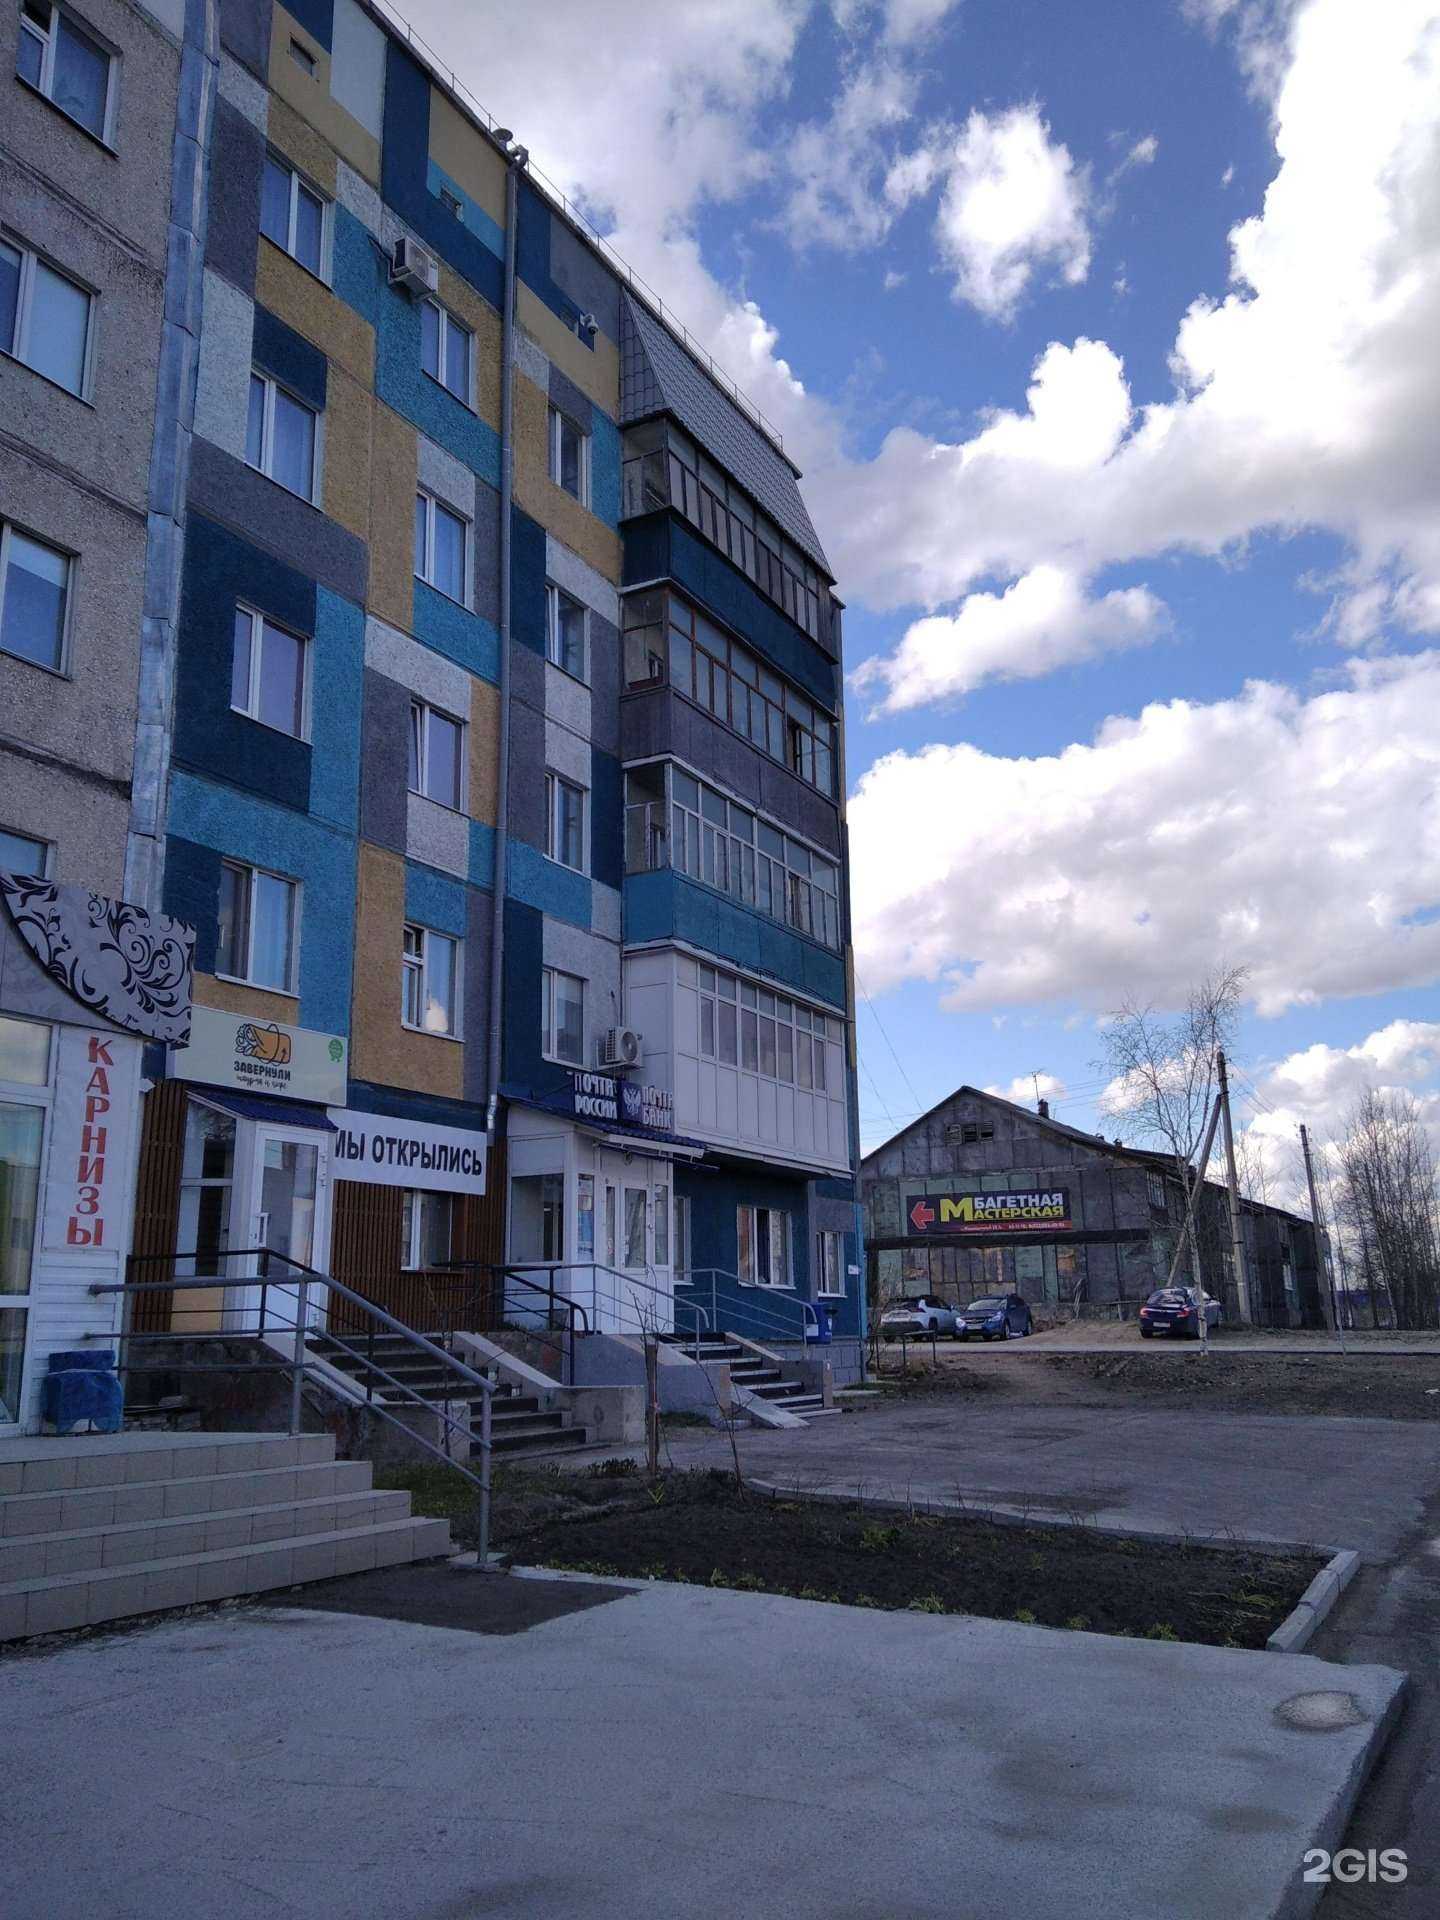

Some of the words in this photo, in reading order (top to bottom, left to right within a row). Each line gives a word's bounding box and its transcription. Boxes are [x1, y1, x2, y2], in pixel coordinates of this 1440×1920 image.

[234, 1061, 291, 1081] ЗАВЕРНУЛИ
[574, 1071, 614, 1097] ПОЧТА
[575, 1094, 618, 1120] РОССИИ
[643, 1107, 672, 1129] БАНК
[67, 1037, 114, 1246] КАРНИЗЫ
[372, 1134, 482, 1176] ОТКРЫЛИСЬ
[940, 1197, 1064, 1222] МАСТЕРСКАЯ
[974, 1192, 1063, 1209] БАГЕТНАЯ
